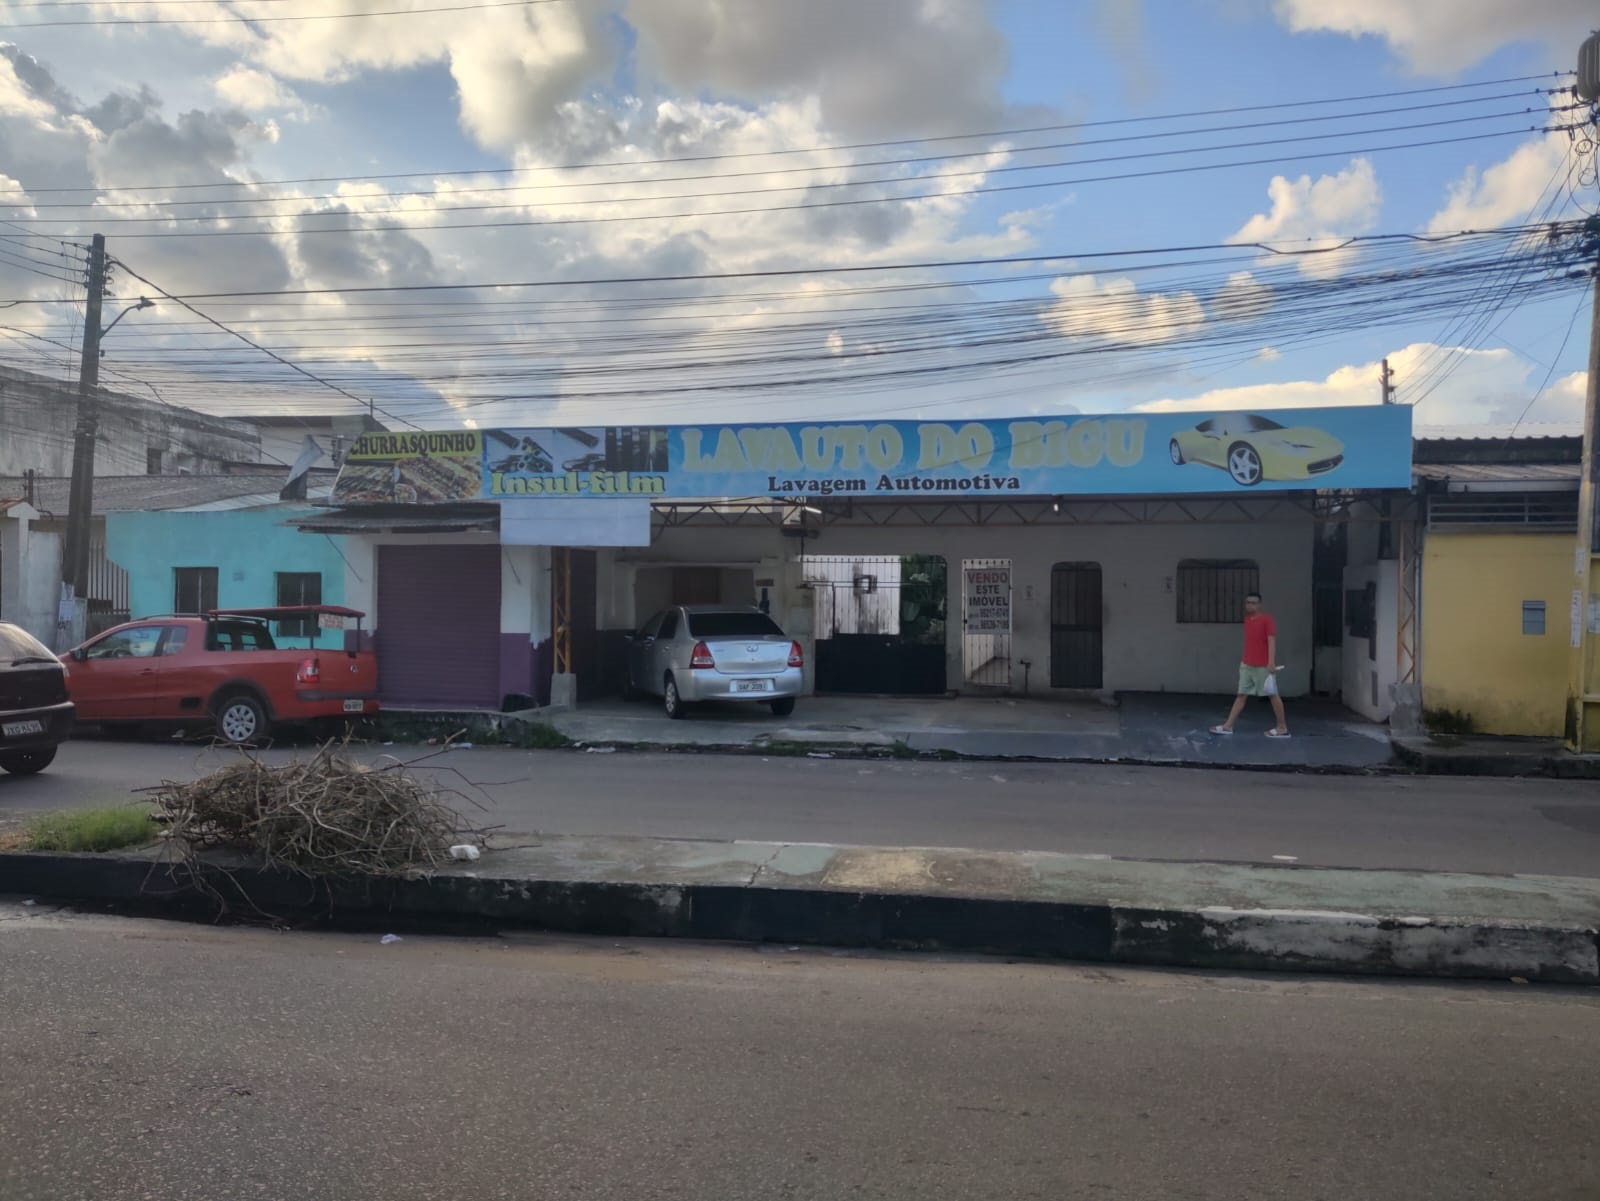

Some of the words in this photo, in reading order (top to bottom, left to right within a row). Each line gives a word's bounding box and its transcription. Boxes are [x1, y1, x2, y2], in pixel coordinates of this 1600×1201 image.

[350, 433, 476, 457] CHURRASQUINHO
[681, 424, 904, 472] LAVAUTO
[917, 422, 994, 470] DO
[490, 470, 666, 495] Insul-film
[767, 476, 866, 494] Lavagem
[875, 474, 1020, 491] Automotiva
[967, 571, 1008, 584] VENDO
[976, 584, 1000, 594] ESTE
[969, 594, 1009, 606] IMÓVEL
